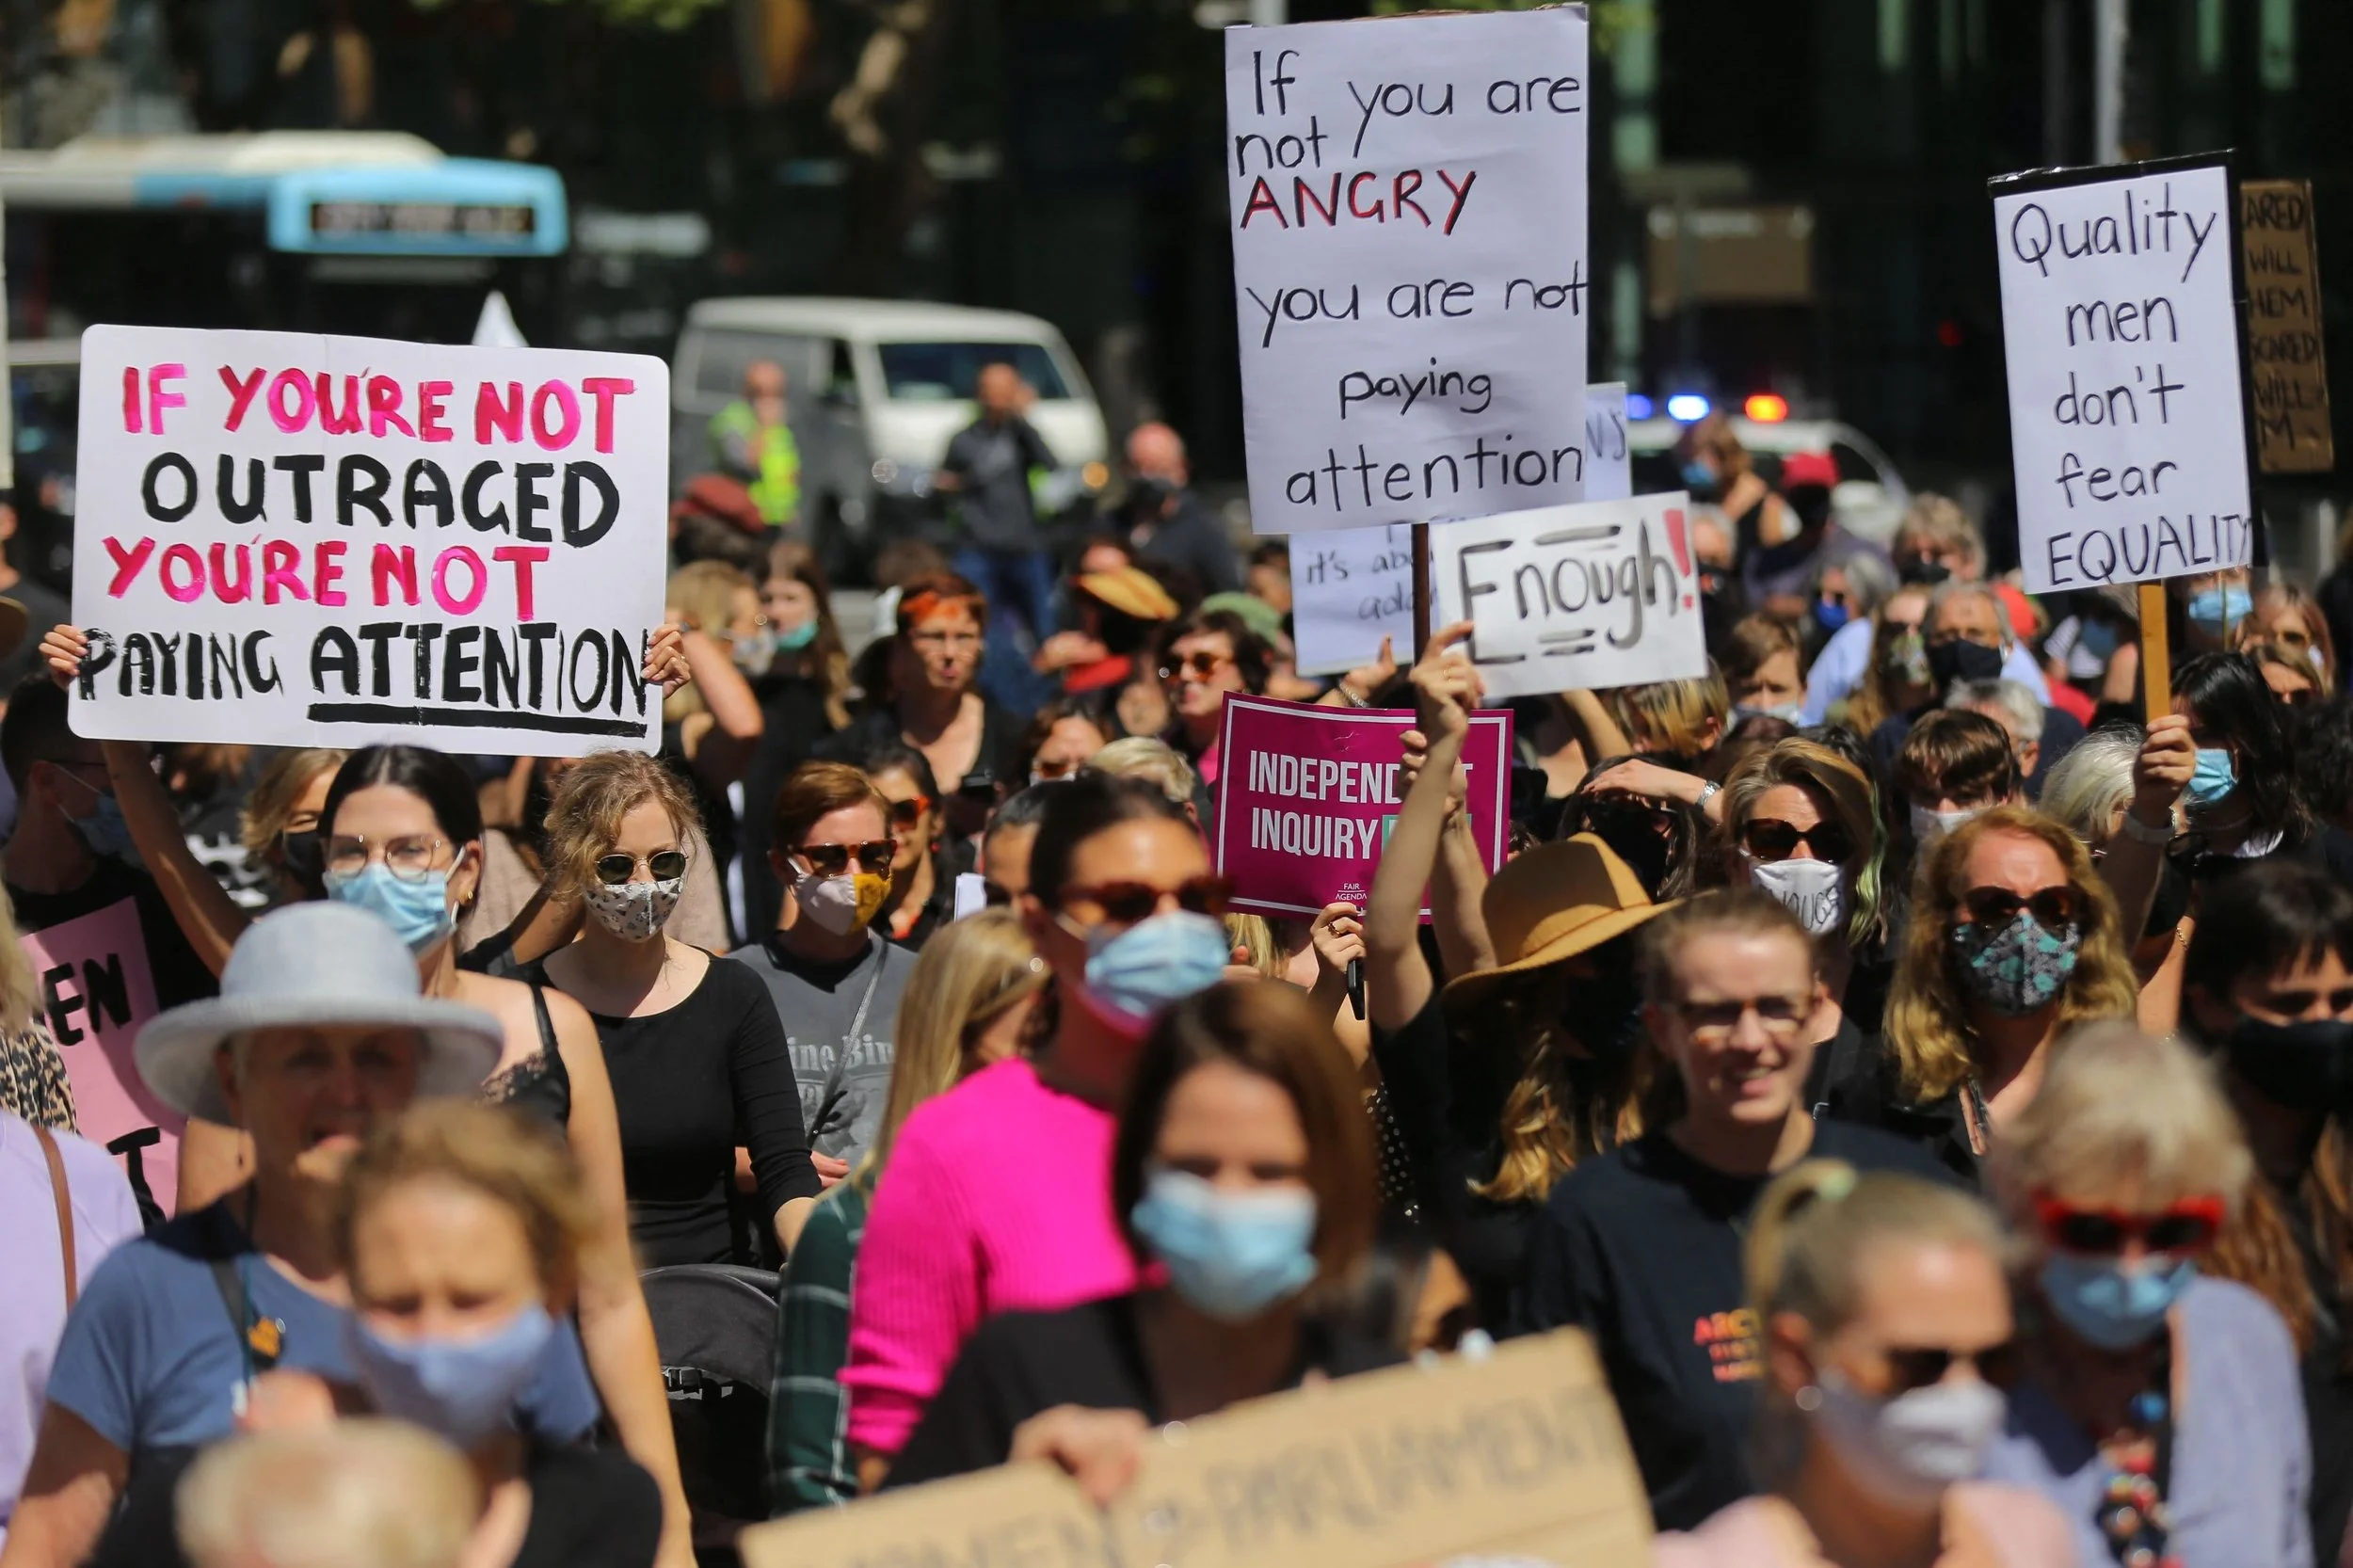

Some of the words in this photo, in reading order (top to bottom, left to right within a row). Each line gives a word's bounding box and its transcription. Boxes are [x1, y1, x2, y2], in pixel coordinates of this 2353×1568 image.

[1252, 50, 1300, 116] If
[1346, 77, 1453, 159] you
[1486, 75, 1581, 114] are
[1234, 116, 1328, 177] not
[1240, 168, 1477, 236] ANGRY
[2010, 181, 2217, 283] Quality
[2247, 192, 2305, 232] ARED
[1245, 284, 1359, 349] you
[1386, 279, 1474, 319] are
[1505, 260, 1587, 316] not
[2066, 296, 2178, 347] men
[122, 363, 185, 435] IF
[217, 366, 455, 442] YOU'RE
[474, 376, 637, 454] NOT
[1339, 357, 1492, 420] paying
[2053, 363, 2185, 426] don't
[141, 452, 620, 549] OUTRAGED
[1286, 435, 1583, 512] attention
[2055, 452, 2179, 508] fear
[103, 534, 350, 606] YOU'RE
[370, 543, 551, 622] NOT
[1307, 550, 1349, 584] it's
[2046, 514, 2252, 586] EQUALITY
[78, 627, 283, 700] PAYING
[310, 621, 648, 717] ATTENTION
[1252, 808, 1378, 859] INQUIRY
[42, 952, 132, 1047] EN
[787, 1036, 836, 1072] ine
